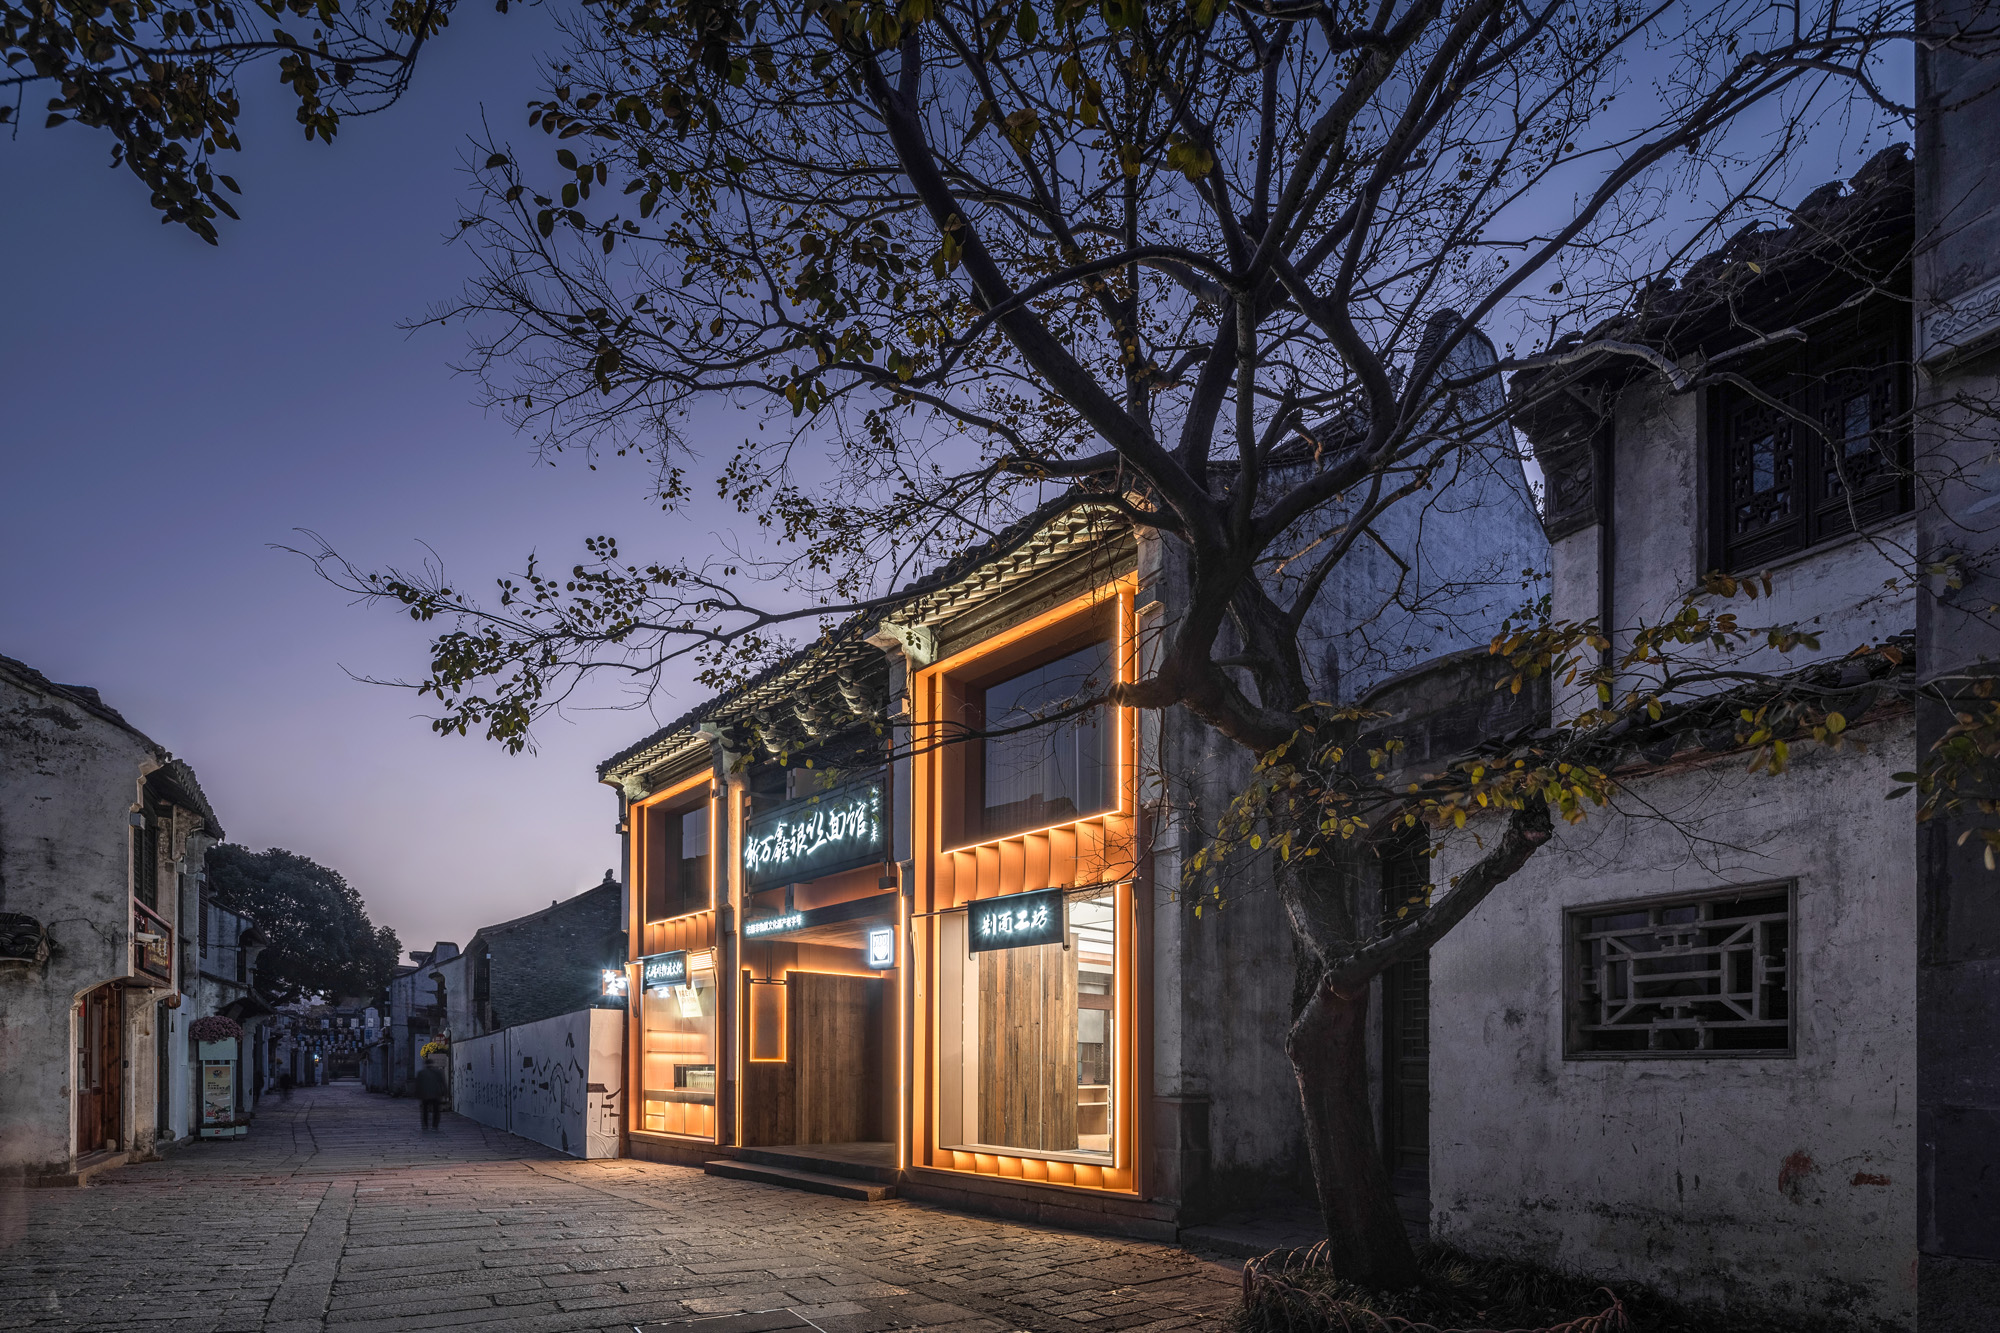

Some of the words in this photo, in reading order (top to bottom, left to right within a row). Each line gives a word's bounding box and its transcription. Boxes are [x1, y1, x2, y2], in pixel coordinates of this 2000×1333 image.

[745, 801, 867, 871] 新万鑫银丝面馆
[982, 905, 1048, 936] 制面工坊
